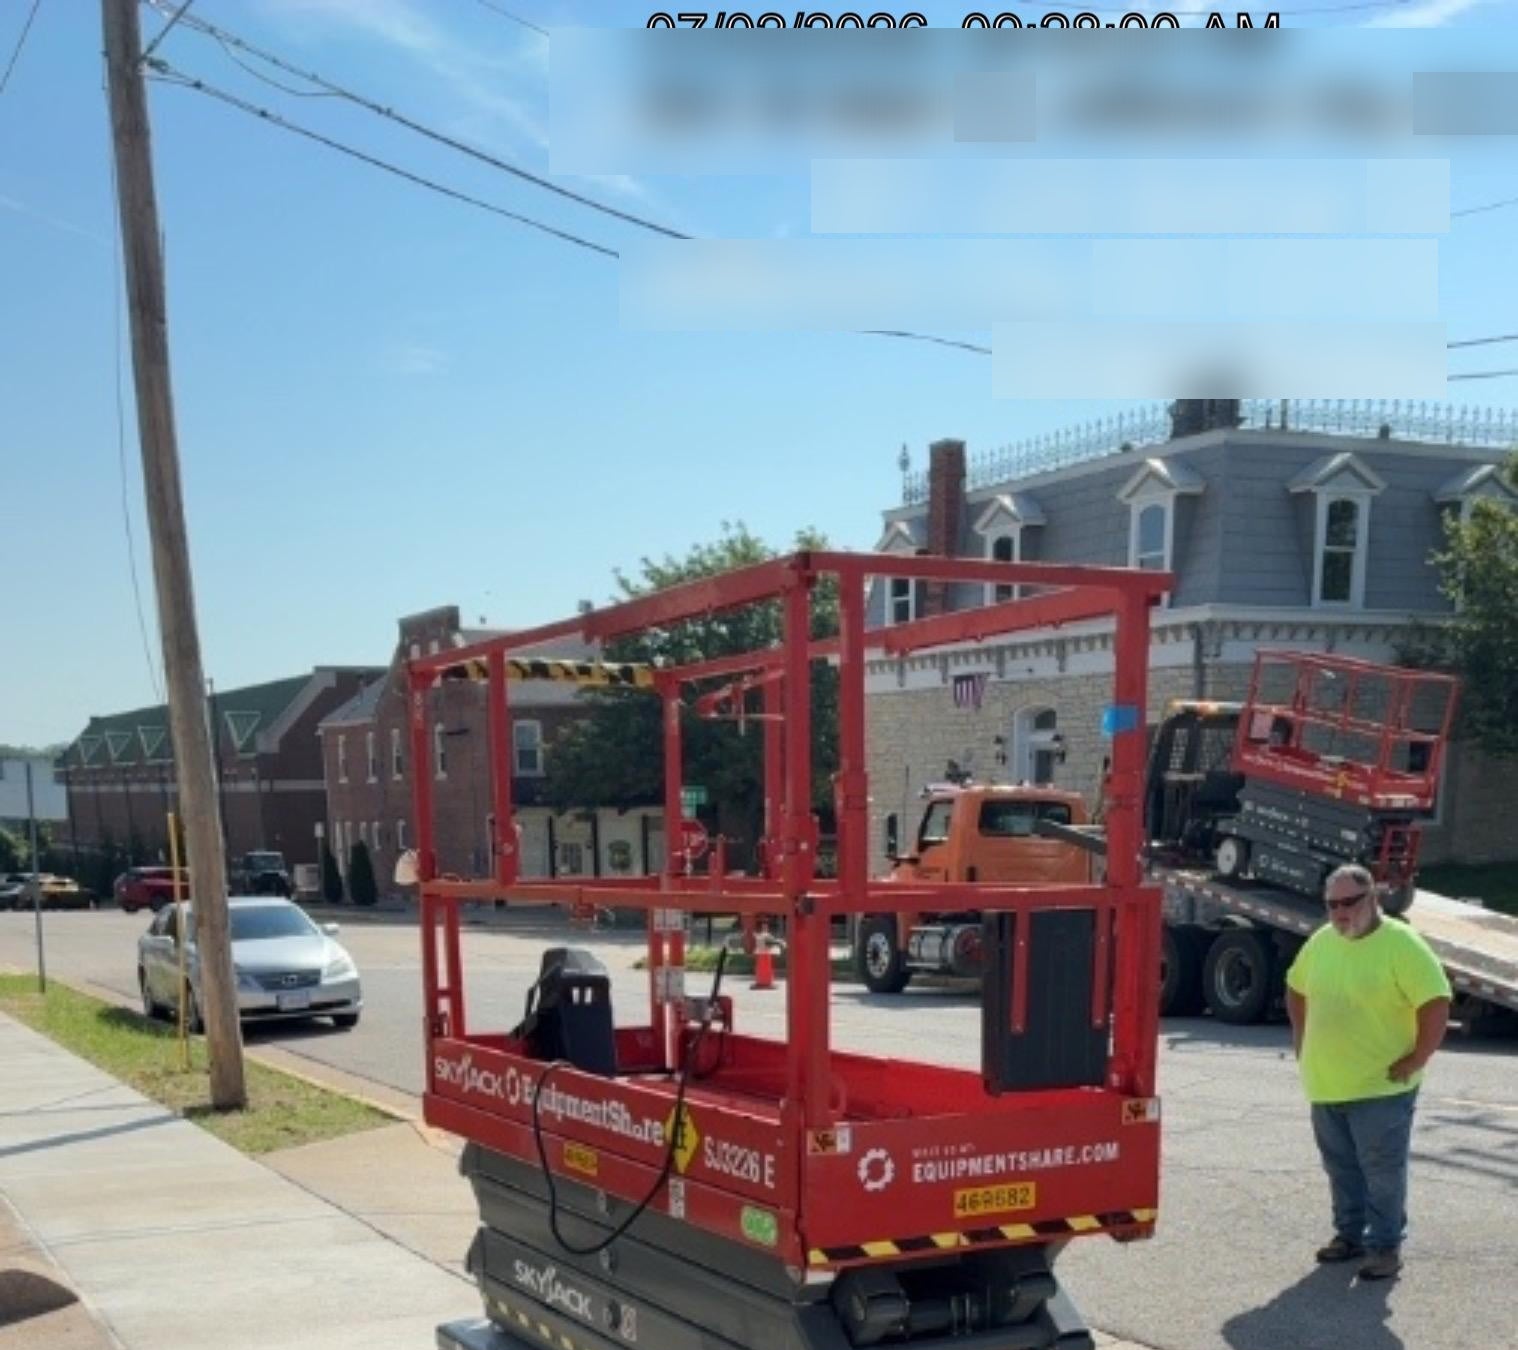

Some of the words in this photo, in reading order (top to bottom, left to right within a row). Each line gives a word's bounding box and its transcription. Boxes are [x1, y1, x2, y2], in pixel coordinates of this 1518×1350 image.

[703, 1135, 760, 1184] SJ3226
[764, 1153, 776, 1190] E
[912, 1142, 1120, 1184] EQUIPMENTSHARE.COM
[513, 1258, 593, 1321] SKYJACK
